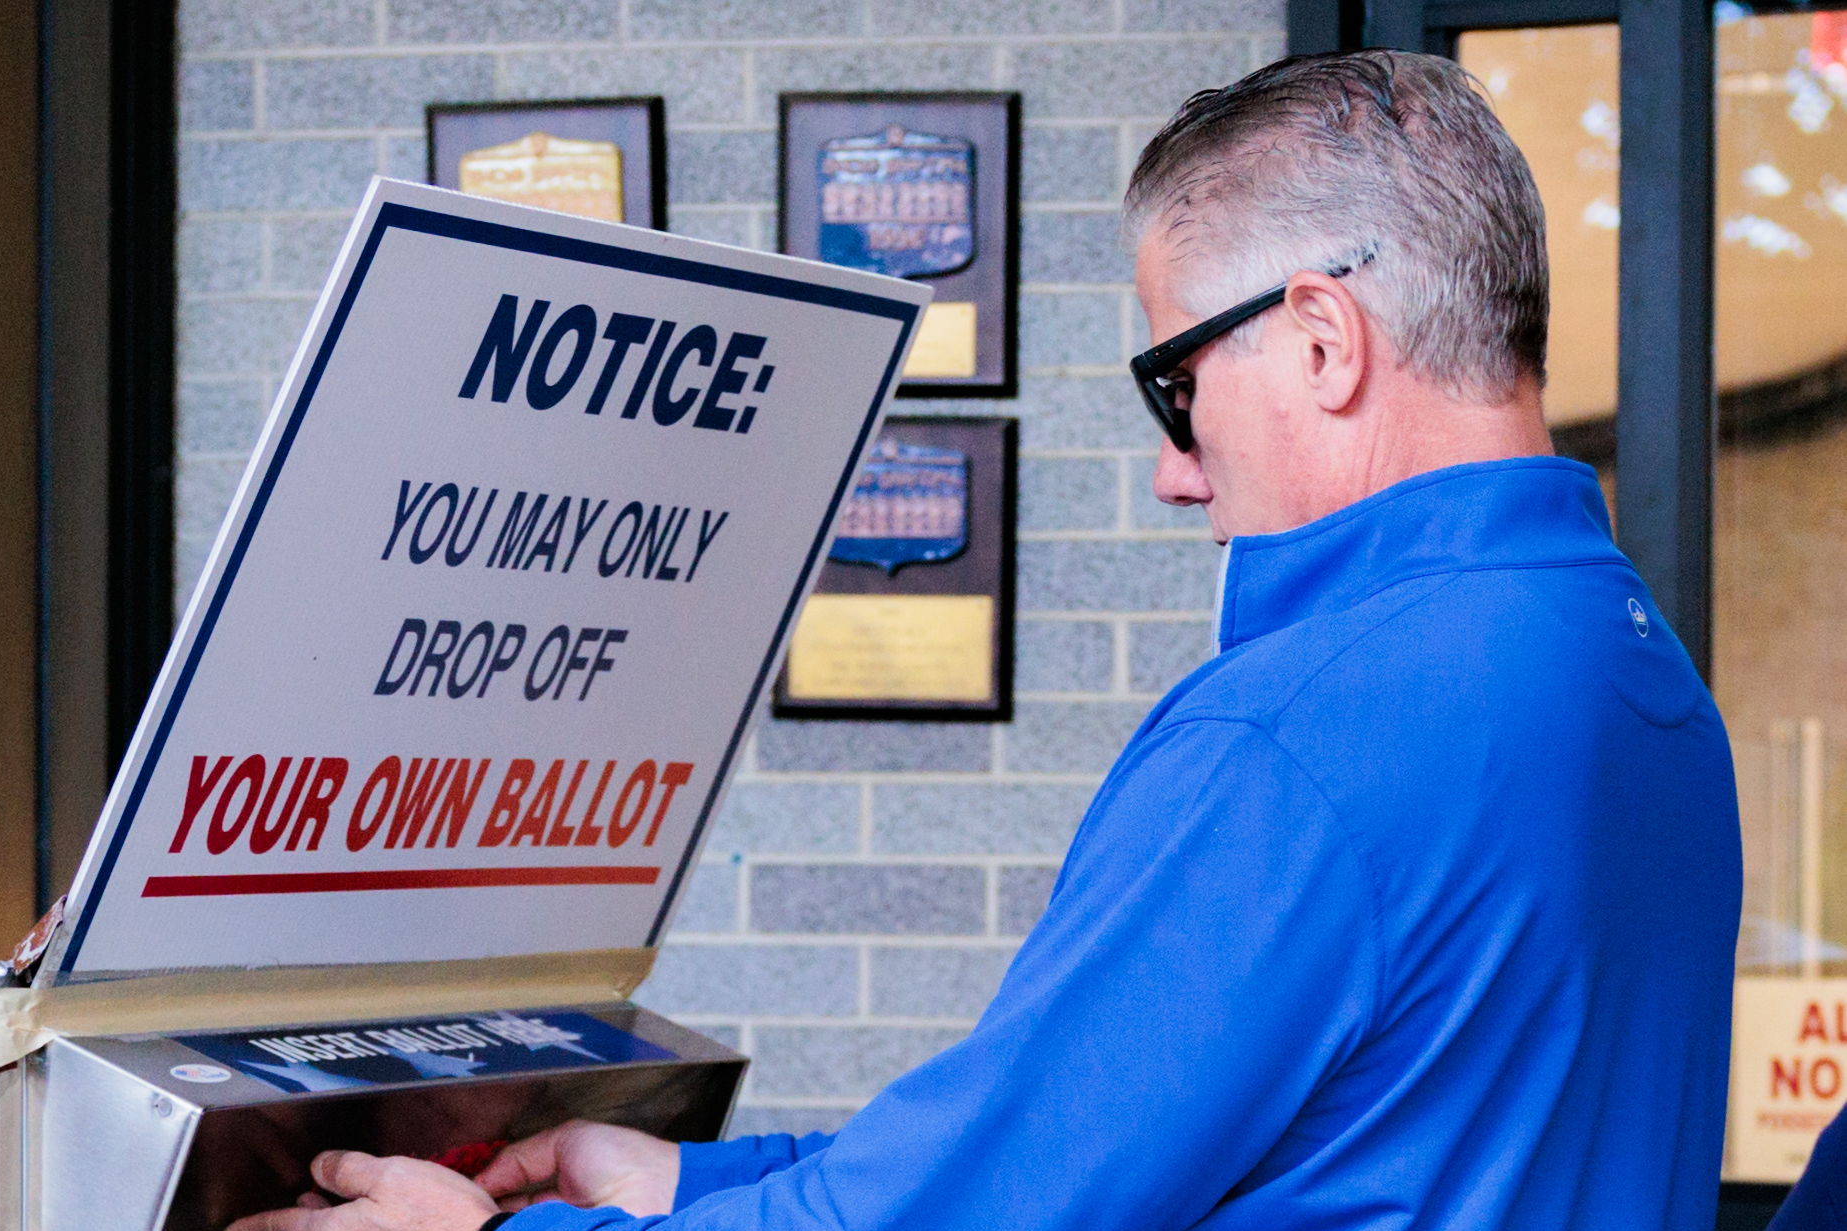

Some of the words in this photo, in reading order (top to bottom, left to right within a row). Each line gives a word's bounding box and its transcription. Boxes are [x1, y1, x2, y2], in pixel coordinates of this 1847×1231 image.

[457, 292, 776, 435] NOTICE:
[380, 480, 498, 568] YOU
[485, 490, 607, 577] MAY
[597, 500, 729, 584] ONLY
[372, 617, 528, 701] DROP
[523, 624, 629, 703] OFF
[167, 754, 350, 856] YOUR
[345, 757, 480, 856] OWN
[476, 758, 694, 851] BALLOT
[248, 1031, 390, 1064] INSERT
[363, 1022, 502, 1054] BALLOT
[1769, 1056, 1841, 1100] NO
